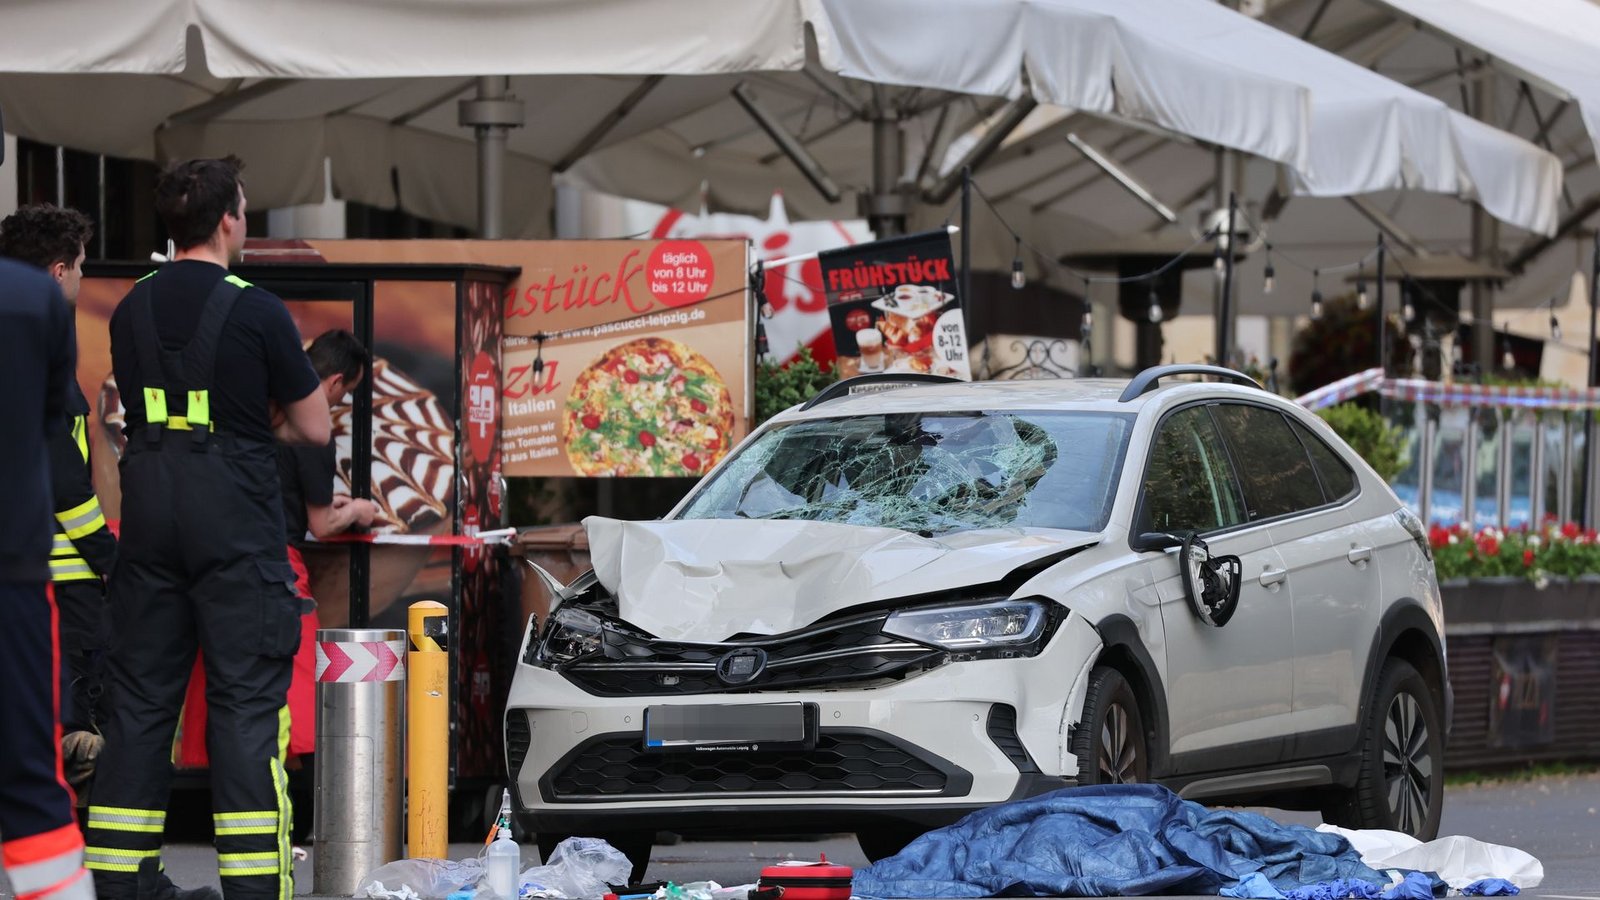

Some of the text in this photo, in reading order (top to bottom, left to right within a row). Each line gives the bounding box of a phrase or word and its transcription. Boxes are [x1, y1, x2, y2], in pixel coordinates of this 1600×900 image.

[662, 252, 698, 267] täglich
[653, 266, 707, 279] von 8 Uhr
[828, 256, 950, 292] FRÜHSTÜCK
[651, 281, 708, 293] bis 12 Uhr
[941, 323, 960, 332] von
[938, 334, 961, 347] 8-12
[945, 349, 963, 361] Uhr
[508, 398, 556, 416] Italien
[540, 420, 556, 432] wir
[517, 434, 558, 448] Tomaten
[511, 452, 528, 463] aus
[529, 446, 559, 459] Italien
